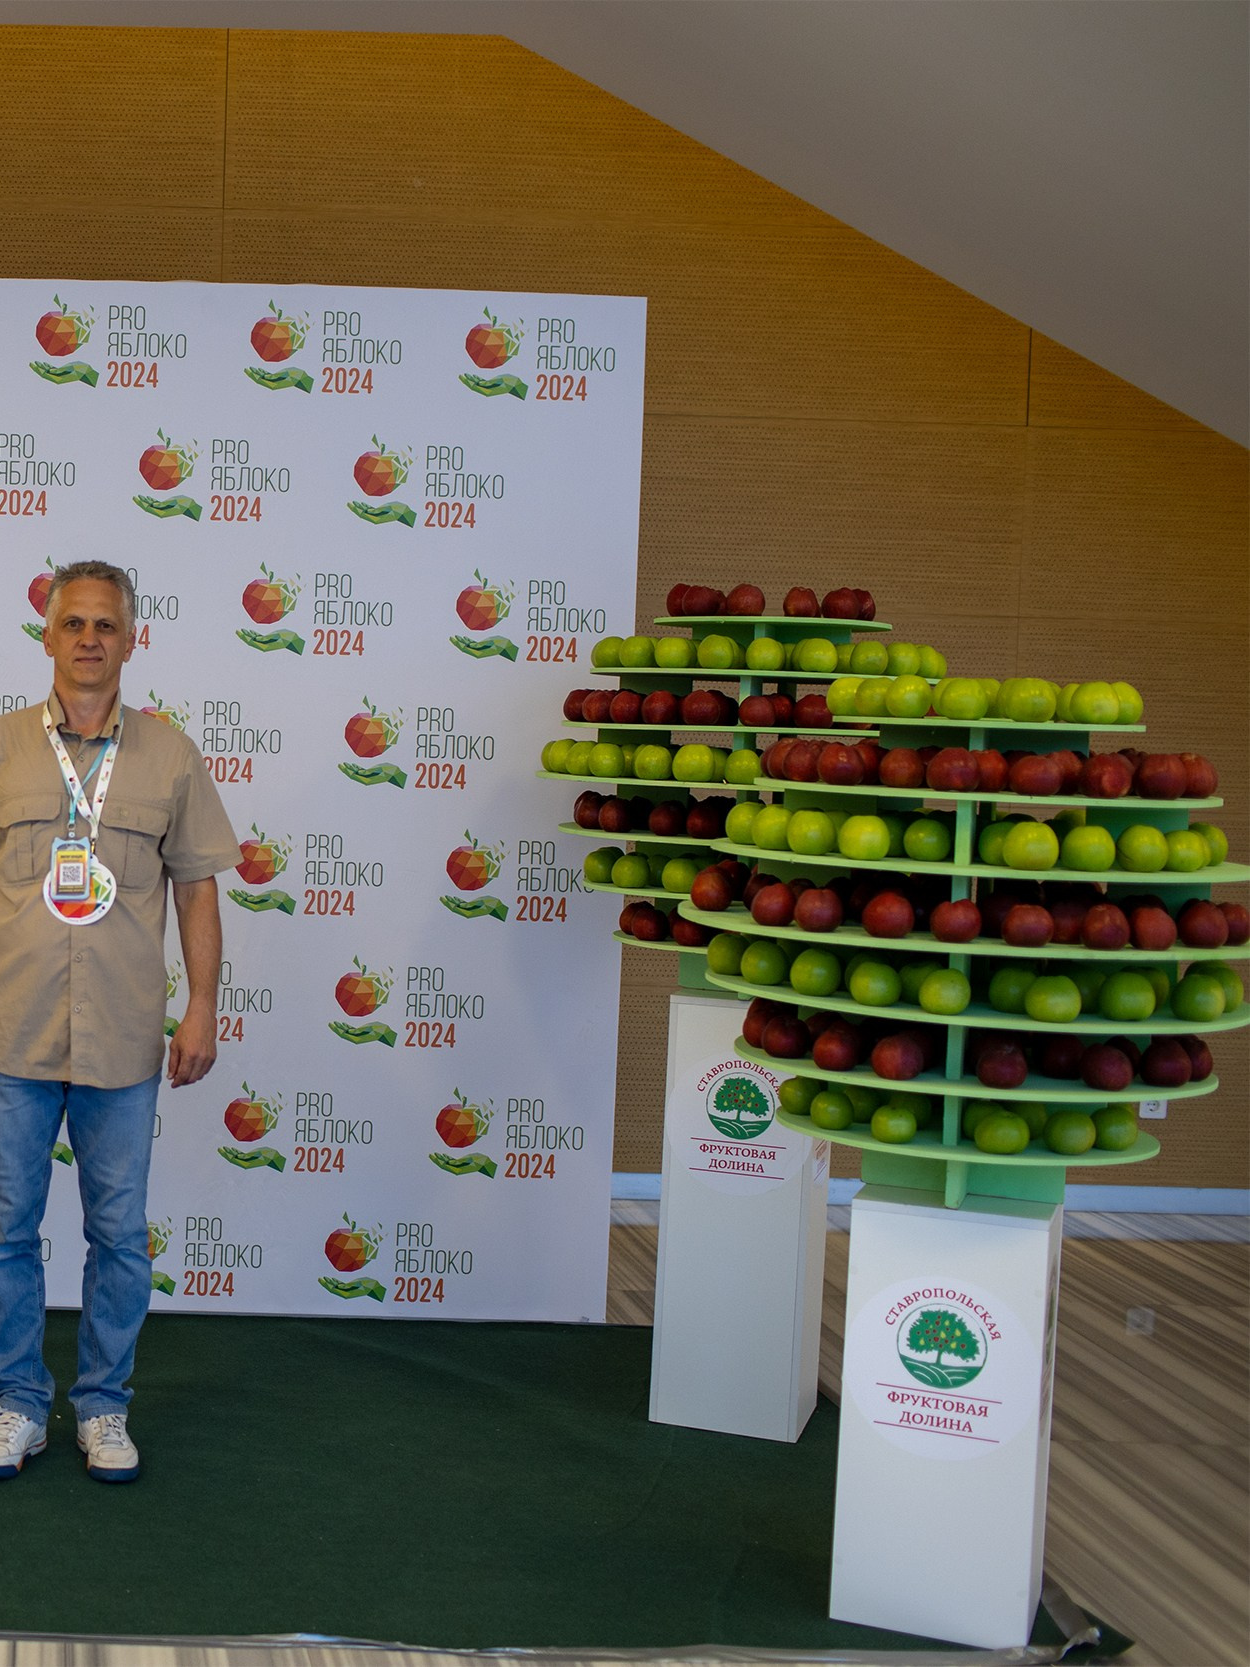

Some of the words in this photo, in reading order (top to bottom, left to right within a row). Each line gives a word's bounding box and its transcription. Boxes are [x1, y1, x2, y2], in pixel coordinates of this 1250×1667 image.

[109, 305, 146, 330] PRO
[324, 311, 360, 336] PRO
[538, 318, 575, 343] PRO
[108, 332, 187, 358] ЯБЛОКО
[323, 338, 401, 364] ЯБЛОКО
[537, 345, 615, 372] ЯБЛОКО
[107, 361, 158, 388] 2024
[321, 367, 373, 394] 2024
[536, 374, 587, 401] 2024
[212, 439, 249, 464] PRO
[426, 446, 463, 471] PRO
[211, 466, 290, 492] ЯБЛОКО
[425, 473, 504, 499] ЯБЛОКО
[210, 495, 262, 522] 2024
[424, 501, 476, 528] 2024
[315, 573, 352, 598] PRO
[528, 580, 565, 605] PRO
[135, 595, 179, 621] ОКО
[314, 600, 392, 626] ЯБЛОКО
[527, 607, 606, 633] ЯБЛОКО
[313, 629, 364, 656] 2024
[526, 636, 577, 663] 2024
[203, 701, 240, 726] PRO
[417, 707, 454, 732] PRO
[203, 728, 281, 754] ЯБЛОКО
[416, 734, 494, 760] ЯБЛОКО
[415, 763, 466, 790] 2024
[306, 834, 342, 859] PRO
[518, 841, 555, 865] PRO
[305, 861, 383, 887] ЯБЛОКО
[304, 889, 355, 916] 2024
[516, 895, 567, 922] 2024
[407, 967, 444, 992] PRO
[219, 988, 272, 1014] ЛОКО
[406, 993, 484, 1019] ЯБЛОКО
[215, 1016, 244, 1042] 24
[404, 1021, 456, 1048] 2024
[697, 1060, 780, 1095] СТАВРОПОЛЬСКА
[296, 1092, 333, 1117] PRO
[507, 1098, 544, 1123] PRO
[295, 1119, 373, 1144] ЯБЛОКО
[506, 1125, 583, 1150] ЯБЛОКО
[294, 1146, 345, 1173] 2024
[699, 1143, 777, 1161] ФРУКТОВАЯ
[504, 1152, 555, 1179] 2024
[708, 1158, 765, 1174] ДОЛИНА
[186, 1217, 222, 1241] PRO
[396, 1223, 433, 1247] PRO
[184, 1243, 262, 1268] ЯБЛОКО
[395, 1249, 472, 1274] ЯБЛОКО
[183, 1271, 234, 1297] 2024
[393, 1277, 444, 1303] 2024
[885, 1288, 1002, 1341] СТАВРОПОЛЬСКАЯ
[887, 1391, 989, 1418] ФРУКТОВАЯ
[899, 1411, 973, 1433] ДОЛИНА
